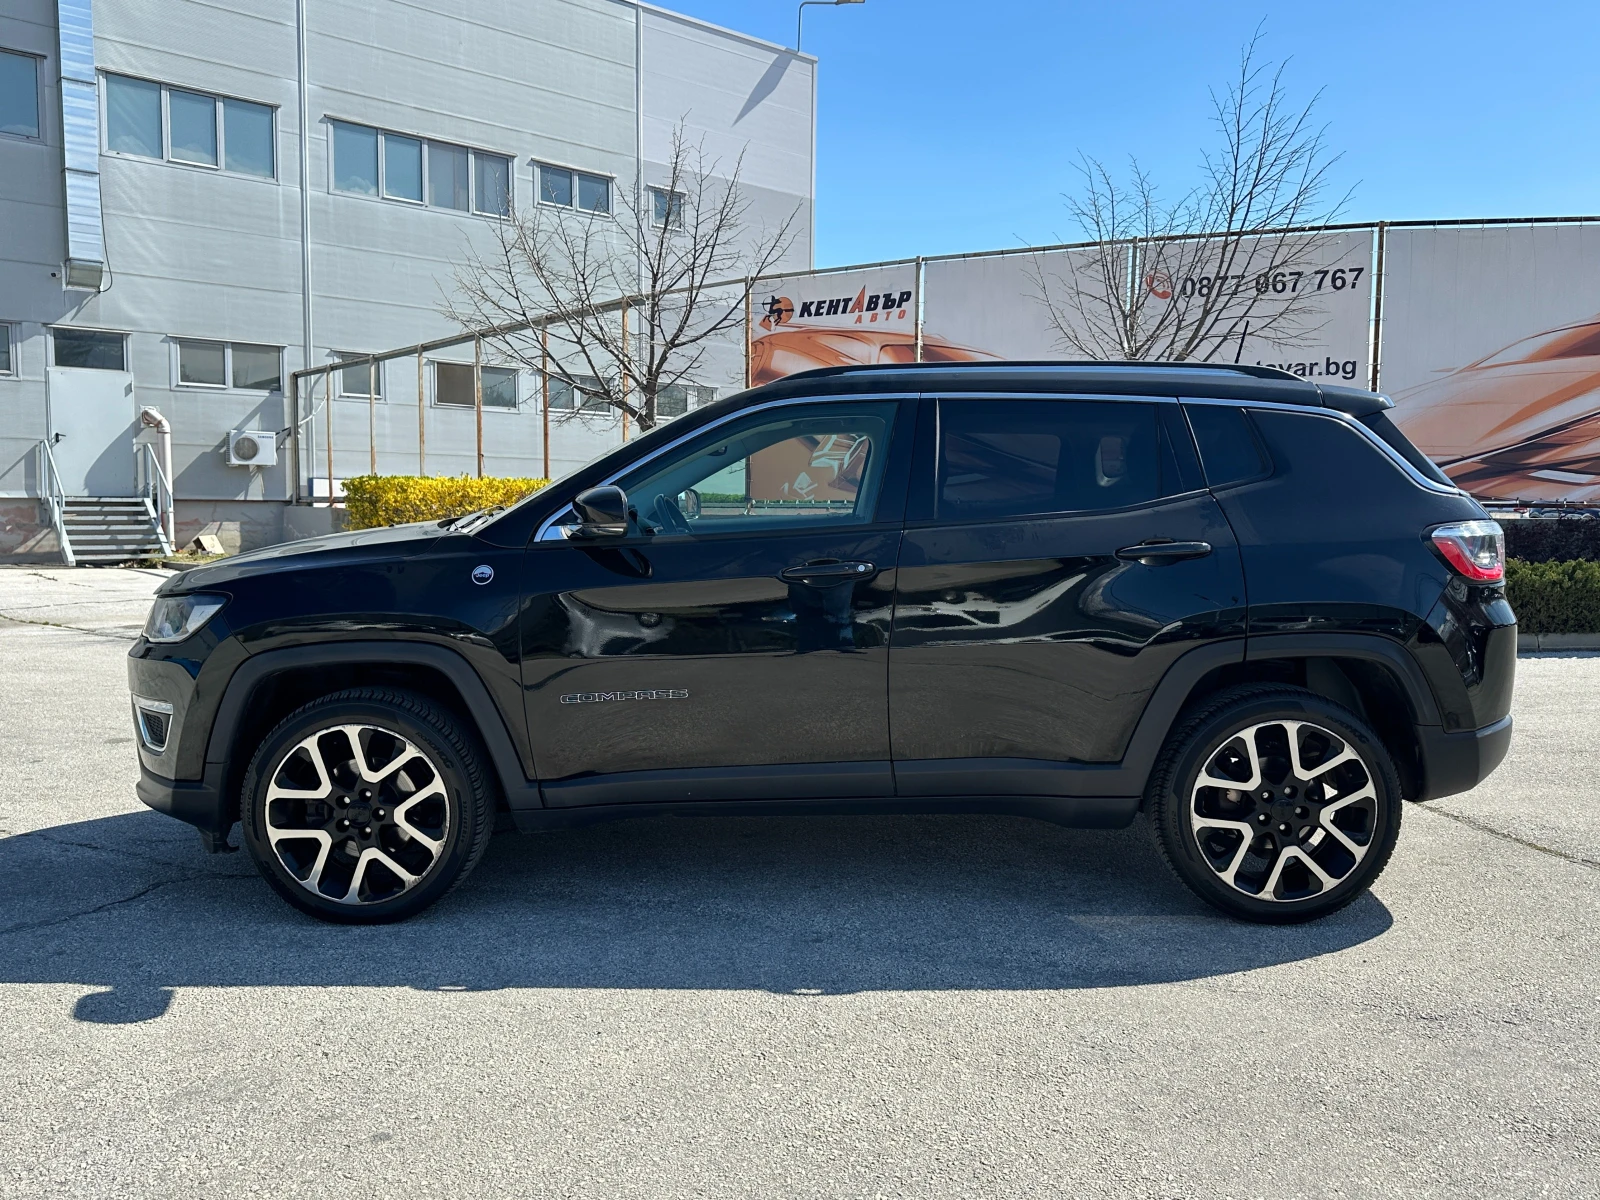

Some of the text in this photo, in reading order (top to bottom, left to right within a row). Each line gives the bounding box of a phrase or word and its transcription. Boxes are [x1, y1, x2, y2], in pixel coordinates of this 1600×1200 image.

[1181, 275, 1245, 298] 0877
[1315, 267, 1364, 292] 767
[799, 284, 912, 317] КЕНТАВЪР
[855, 309, 906, 324] АВТО
[560, 689, 688, 703] COMPASS
